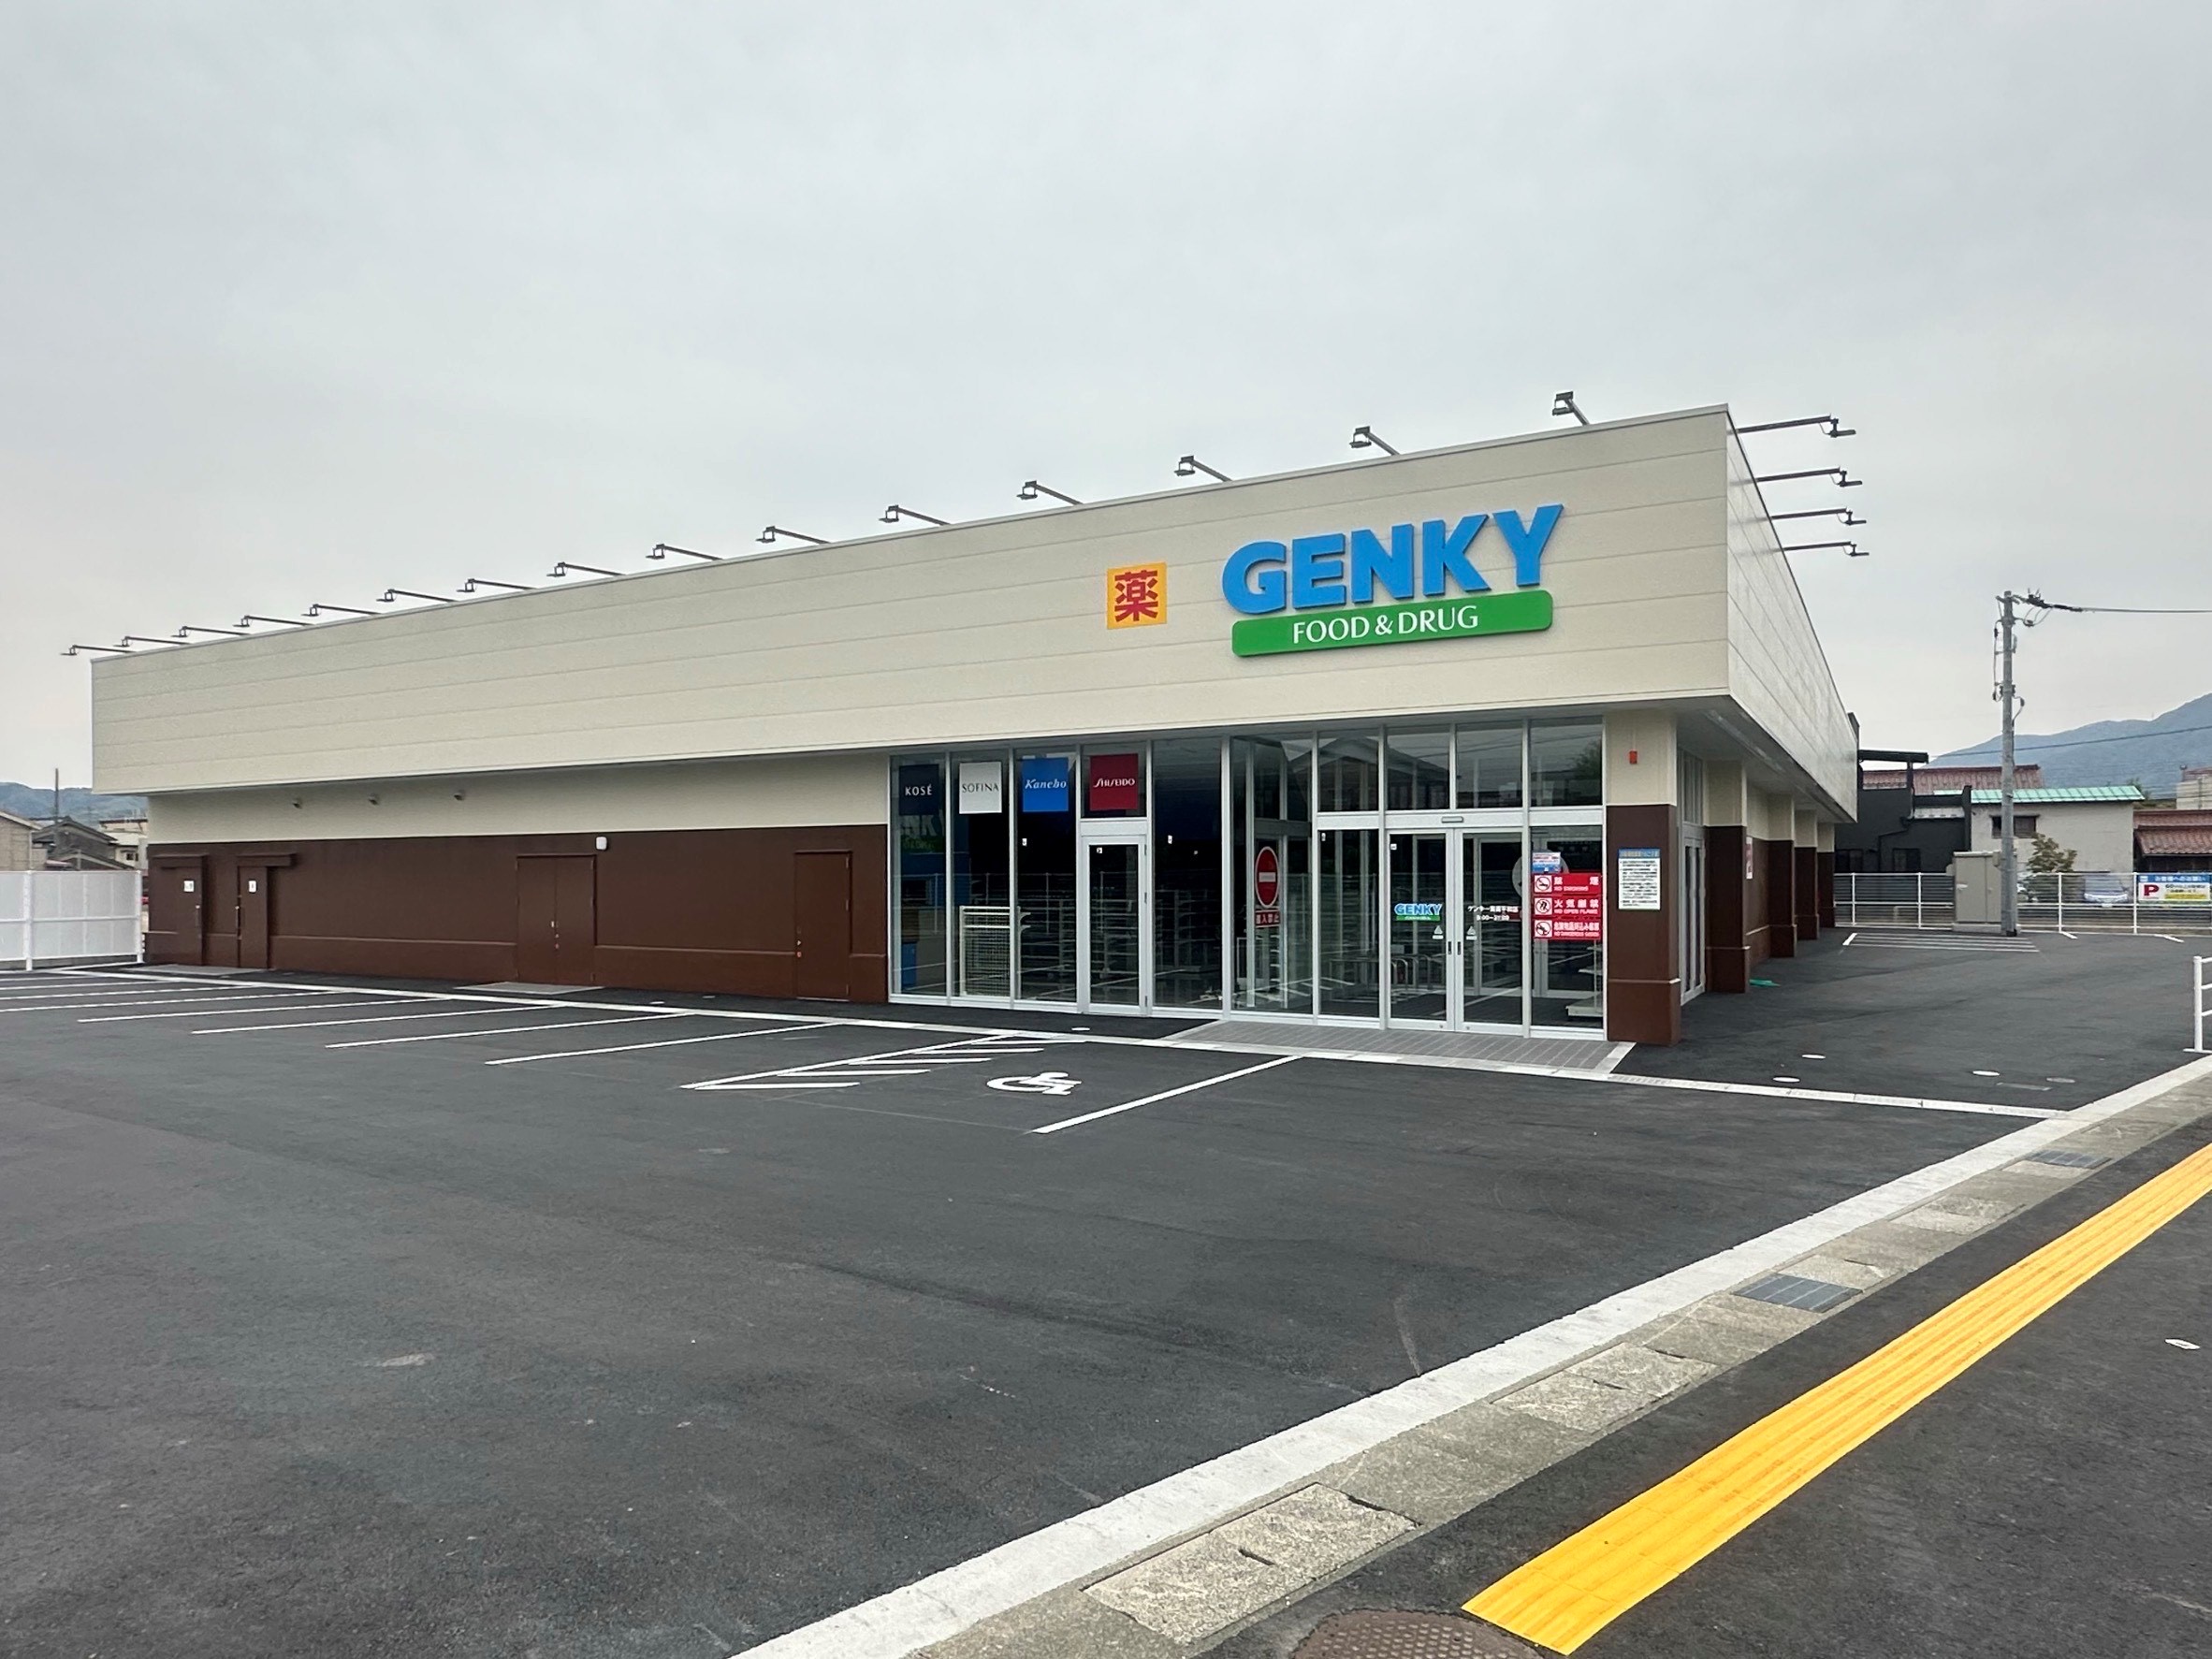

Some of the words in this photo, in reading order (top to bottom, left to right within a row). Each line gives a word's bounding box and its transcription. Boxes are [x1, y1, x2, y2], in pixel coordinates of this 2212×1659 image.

[1222, 503, 1564, 615] GENKY
[1114, 570, 1159, 622] 薬
[1293, 617, 1370, 645] FOOD
[1375, 615, 1394, 635] &
[1399, 605, 1479, 633] DRUG
[905, 783, 933, 795] KOSÉ
[962, 781, 999, 793] SOFINA
[1025, 779, 1067, 789] Kanebo
[1093, 778, 1136, 788] SHISEIDO
[2144, 884, 2160, 895] P
[1394, 903, 1442, 915] GENKY
